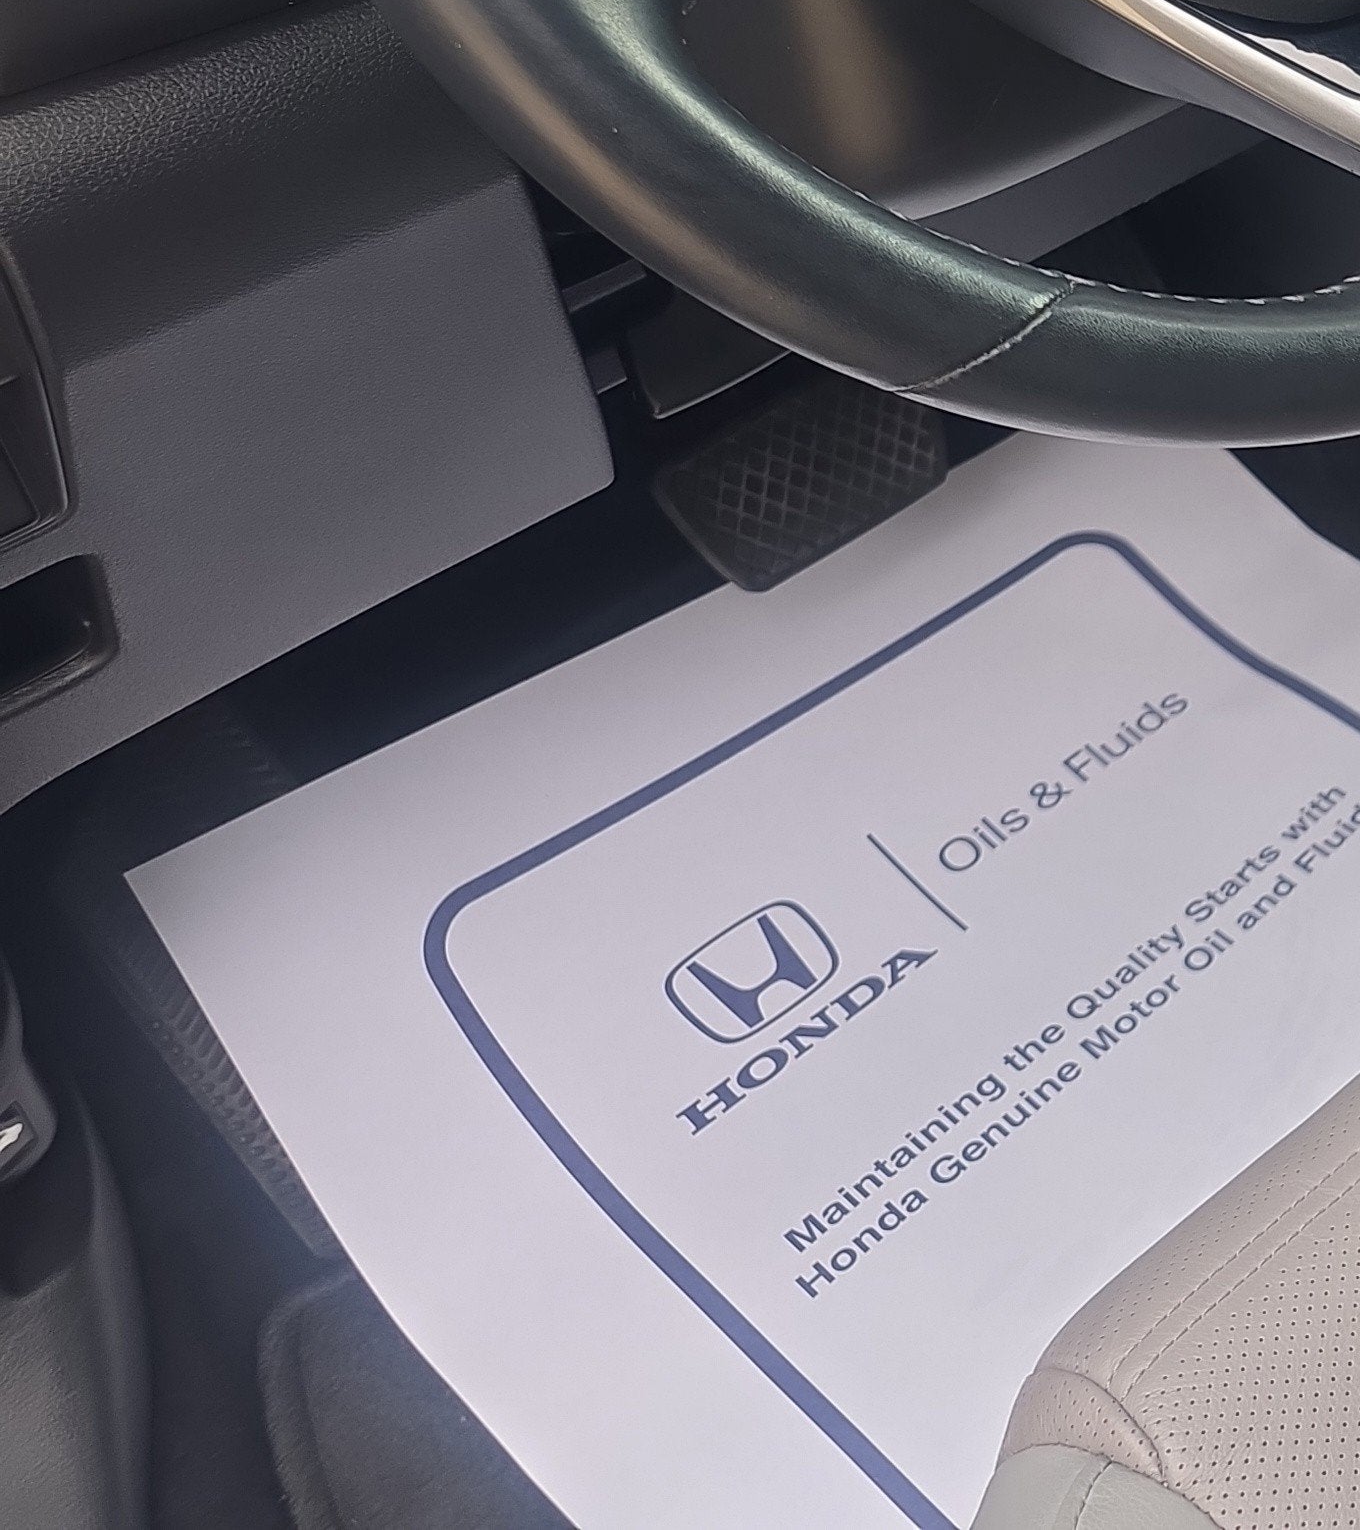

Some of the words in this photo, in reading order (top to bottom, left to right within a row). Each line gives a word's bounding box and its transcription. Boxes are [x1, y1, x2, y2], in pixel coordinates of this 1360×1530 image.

[939, 807, 1030, 872] Oils
[1029, 781, 1073, 808] &
[1062, 692, 1189, 782] Fluids
[676, 947, 939, 1136] HONDA
[783, 1072, 1007, 1253] Maintaining
[1002, 1022, 1066, 1071] the
[1066, 924, 1186, 1020] Quality
[1184, 845, 1281, 923] Starts
[1281, 786, 1346, 841] with
[794, 1187, 930, 1299] Honda
[929, 1060, 1083, 1184] Genuine
[1079, 973, 1181, 1060] Motor
[1183, 928, 1235, 972] Oil
[1236, 873, 1298, 930] and
